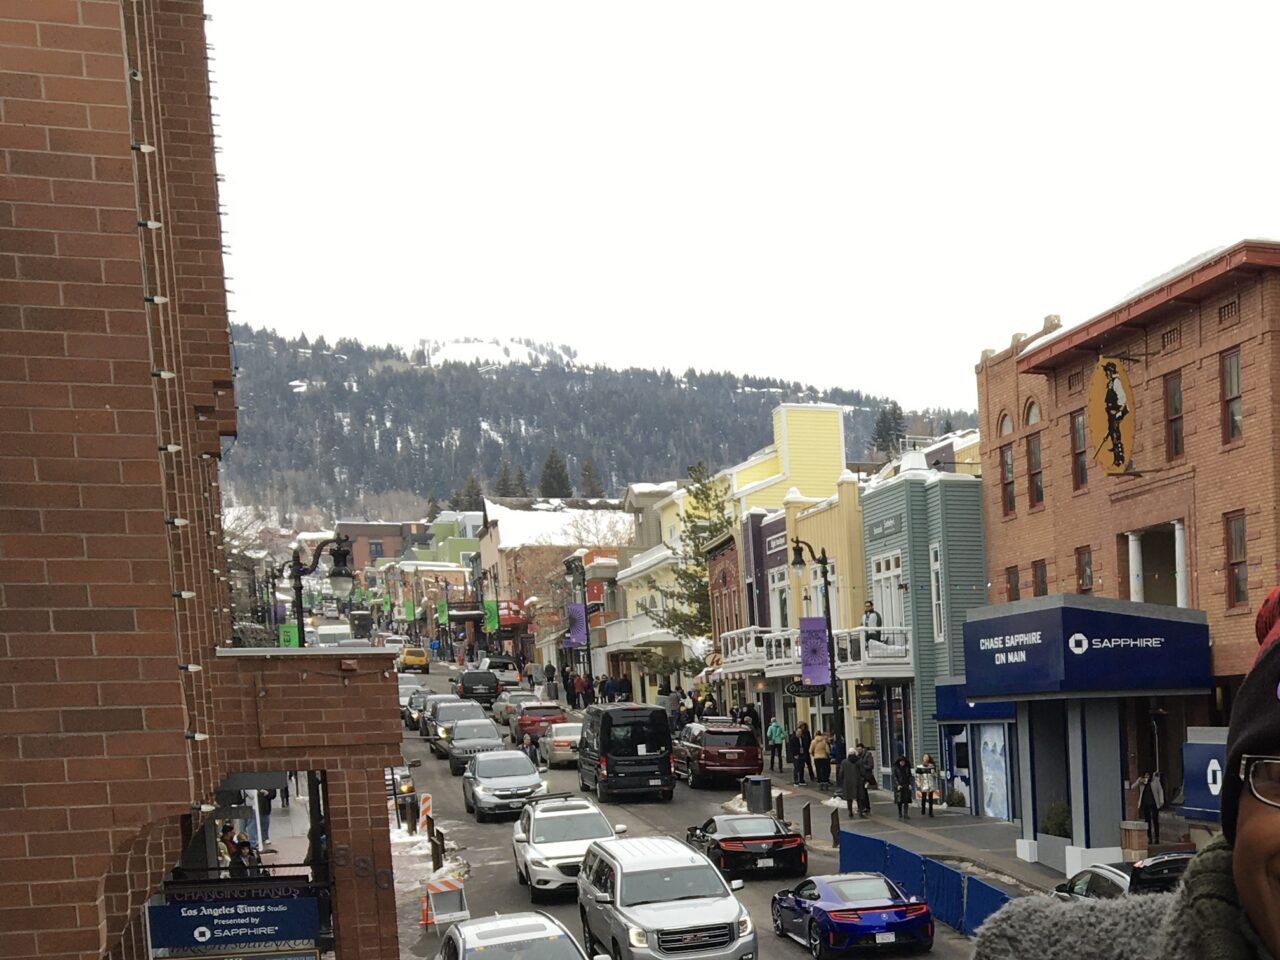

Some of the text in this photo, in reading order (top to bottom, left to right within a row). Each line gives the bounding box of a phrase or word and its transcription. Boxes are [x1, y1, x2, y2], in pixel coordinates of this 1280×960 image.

[979, 631, 1042, 650] CHASE SAPPHIRE
[1092, 637, 1162, 649] SAPPHIRE
[995, 650, 1026, 665] ON MAIN
[174, 888, 247, 901] CHANGING
[181, 907, 198, 917] Los
[200, 906, 235, 917] Angeles
[236, 905, 265, 914] Times
[213, 917, 249, 925] Presented
[213, 927, 276, 937] SAPPHIRE
